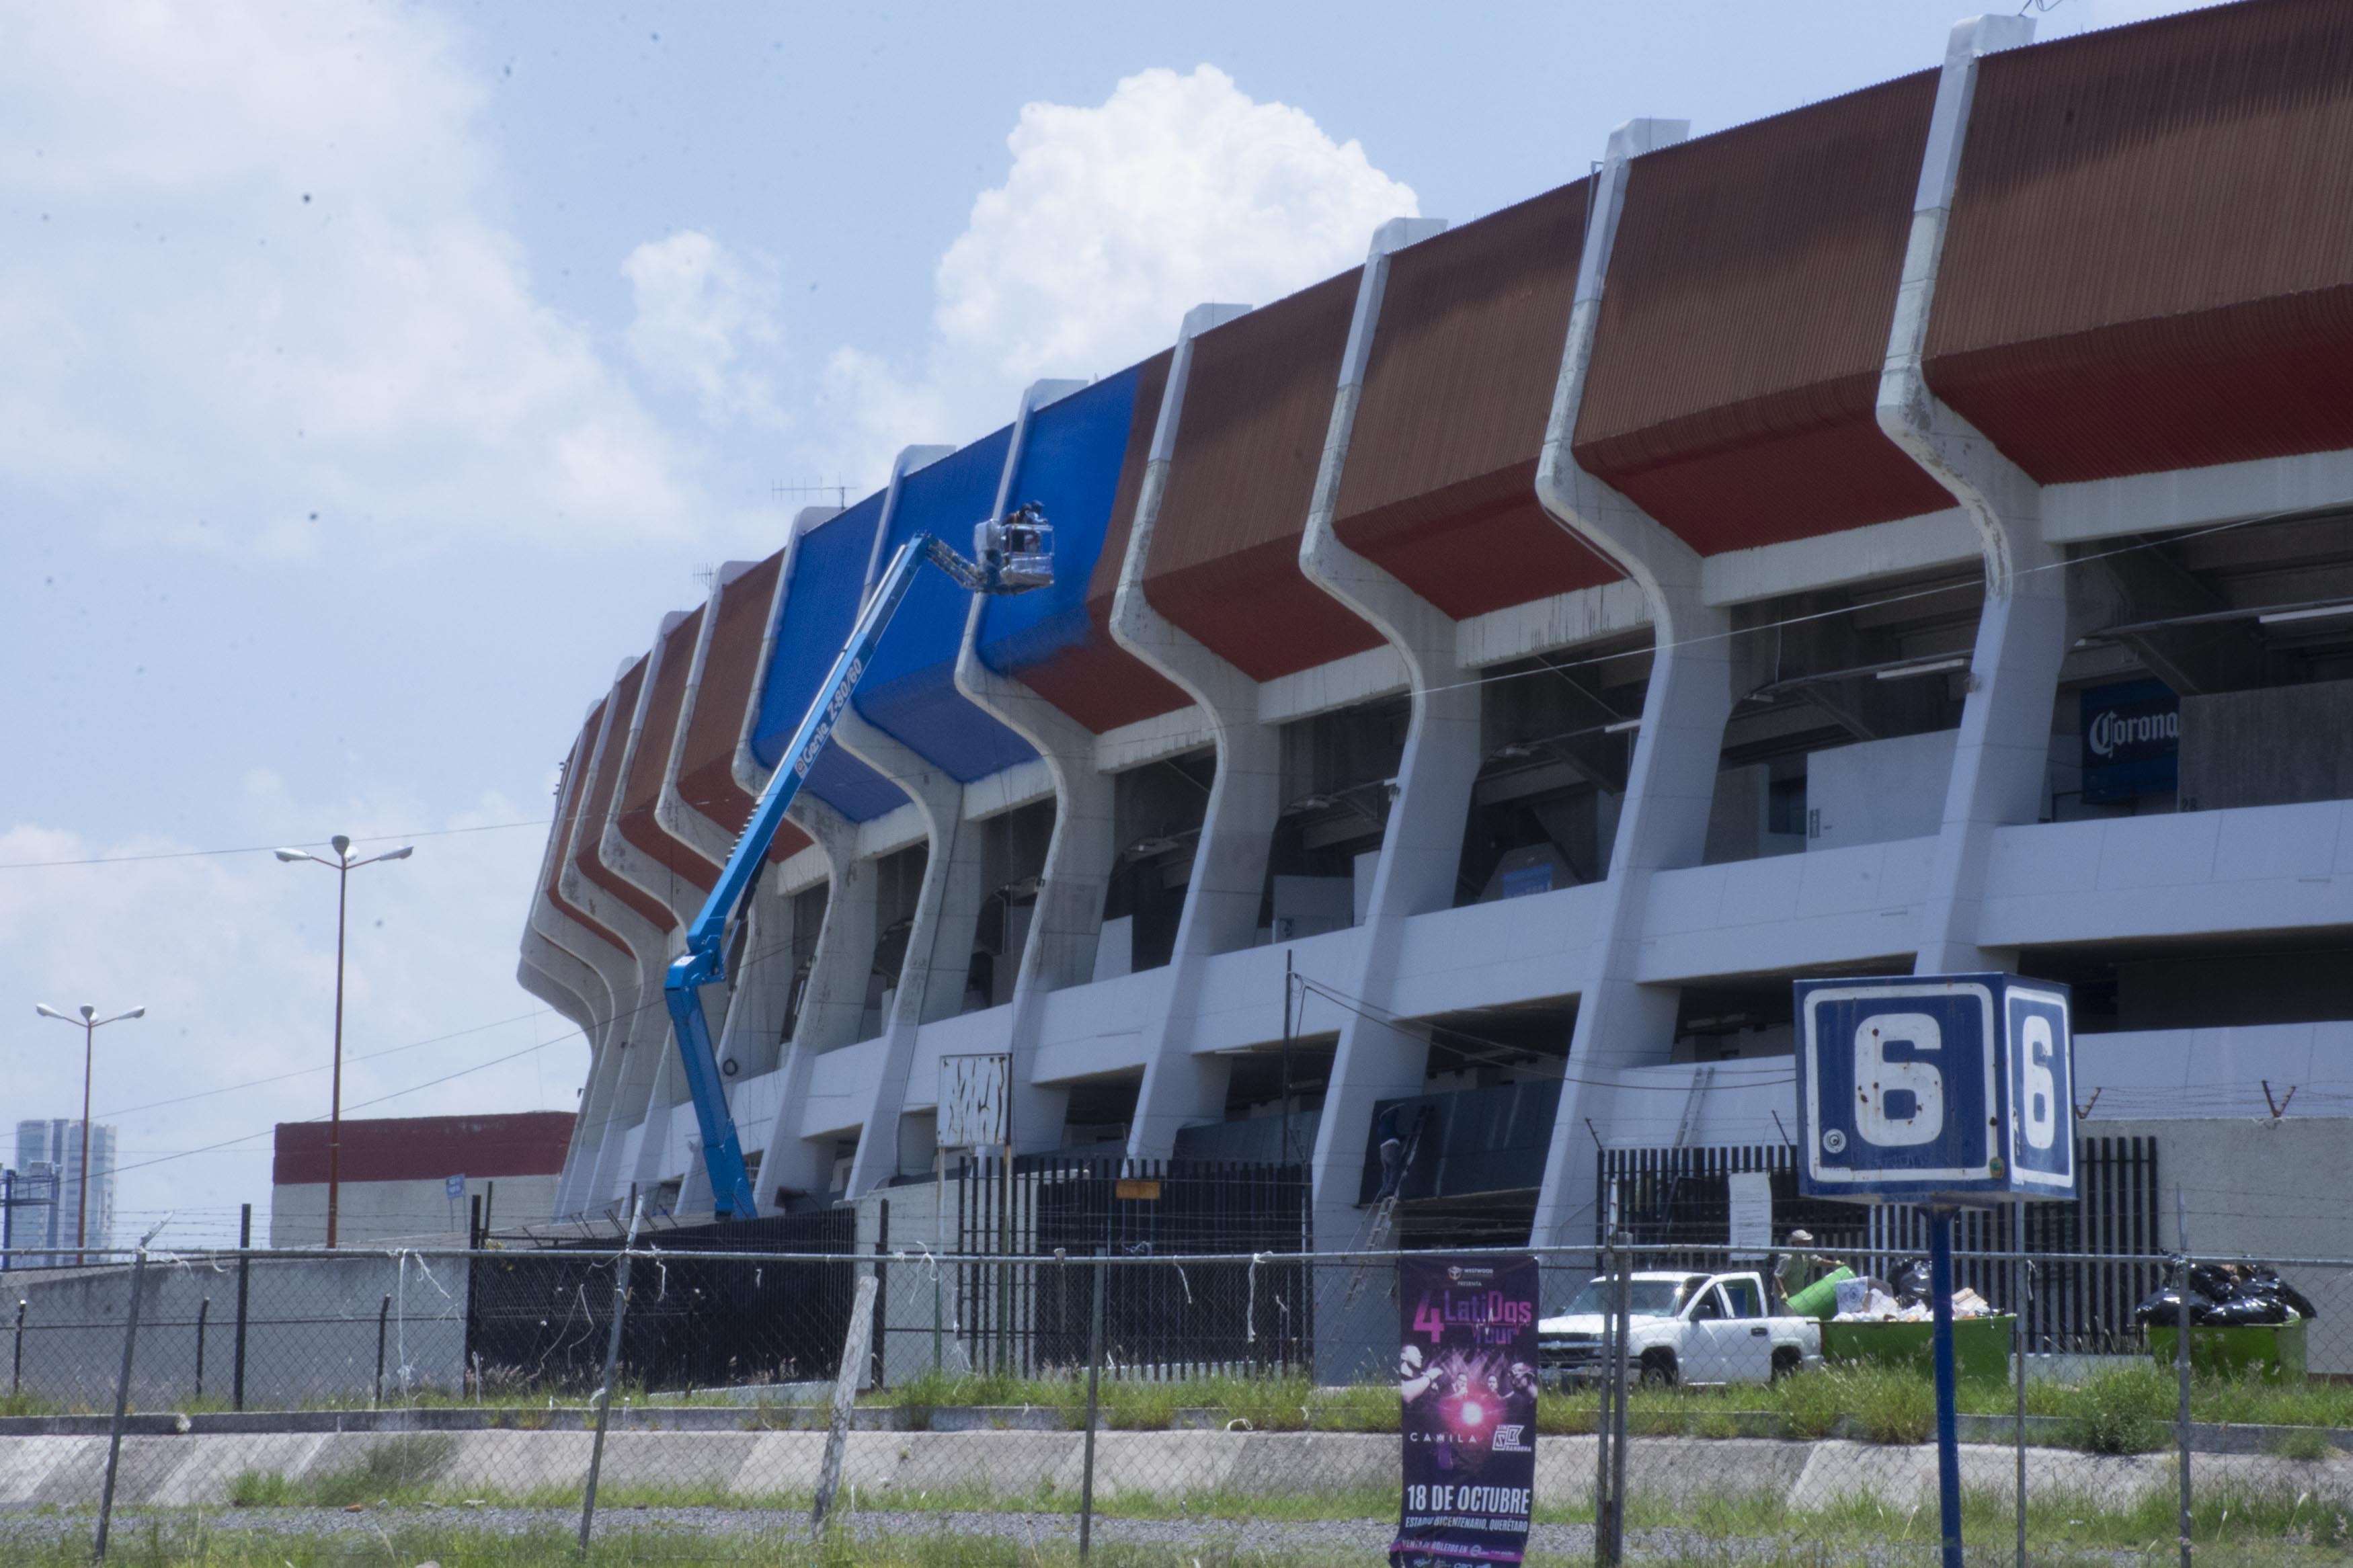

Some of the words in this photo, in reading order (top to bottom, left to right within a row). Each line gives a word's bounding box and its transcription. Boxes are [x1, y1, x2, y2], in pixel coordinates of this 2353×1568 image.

[803, 723, 829, 763] Genie
[827, 657, 863, 720] Z-80/60
[2089, 710, 2180, 758] Corona
[1854, 1012, 1944, 1147] 6
[2022, 1015, 2055, 1149] 6
[1413, 1290, 1445, 1343] 4
[1444, 1290, 1532, 1323] LatiDos
[1410, 1432, 1478, 1444] CAMILA
[1407, 1484, 1427, 1511] 18
[1431, 1485, 1454, 1511] DE
[1457, 1485, 1531, 1514] OCTUBRE
